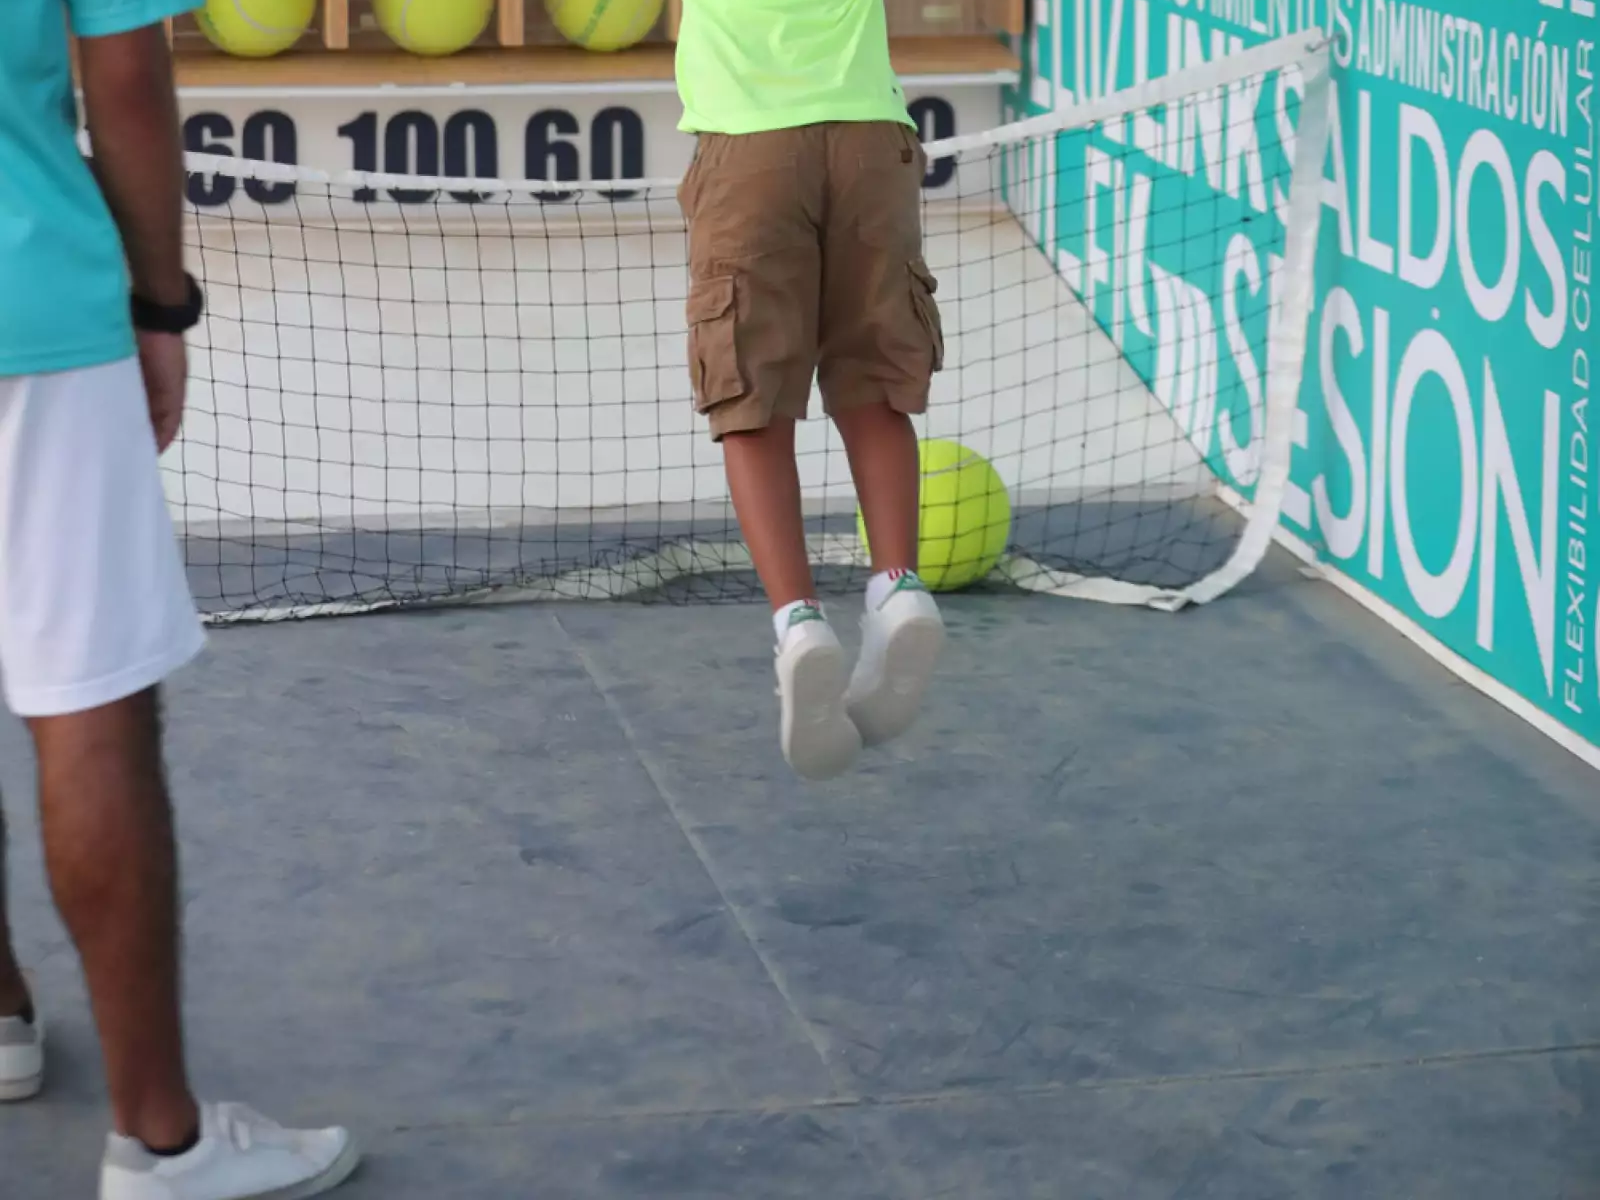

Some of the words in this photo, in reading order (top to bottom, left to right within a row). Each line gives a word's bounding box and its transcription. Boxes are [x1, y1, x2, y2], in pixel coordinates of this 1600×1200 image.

[183, 108, 297, 206] 60
[337, 108, 500, 204] 100
[524, 107, 645, 202] 60
[1571, 40, 1595, 333] CELULAR
[1563, 349, 1591, 715] FLEXIBILIDAD
